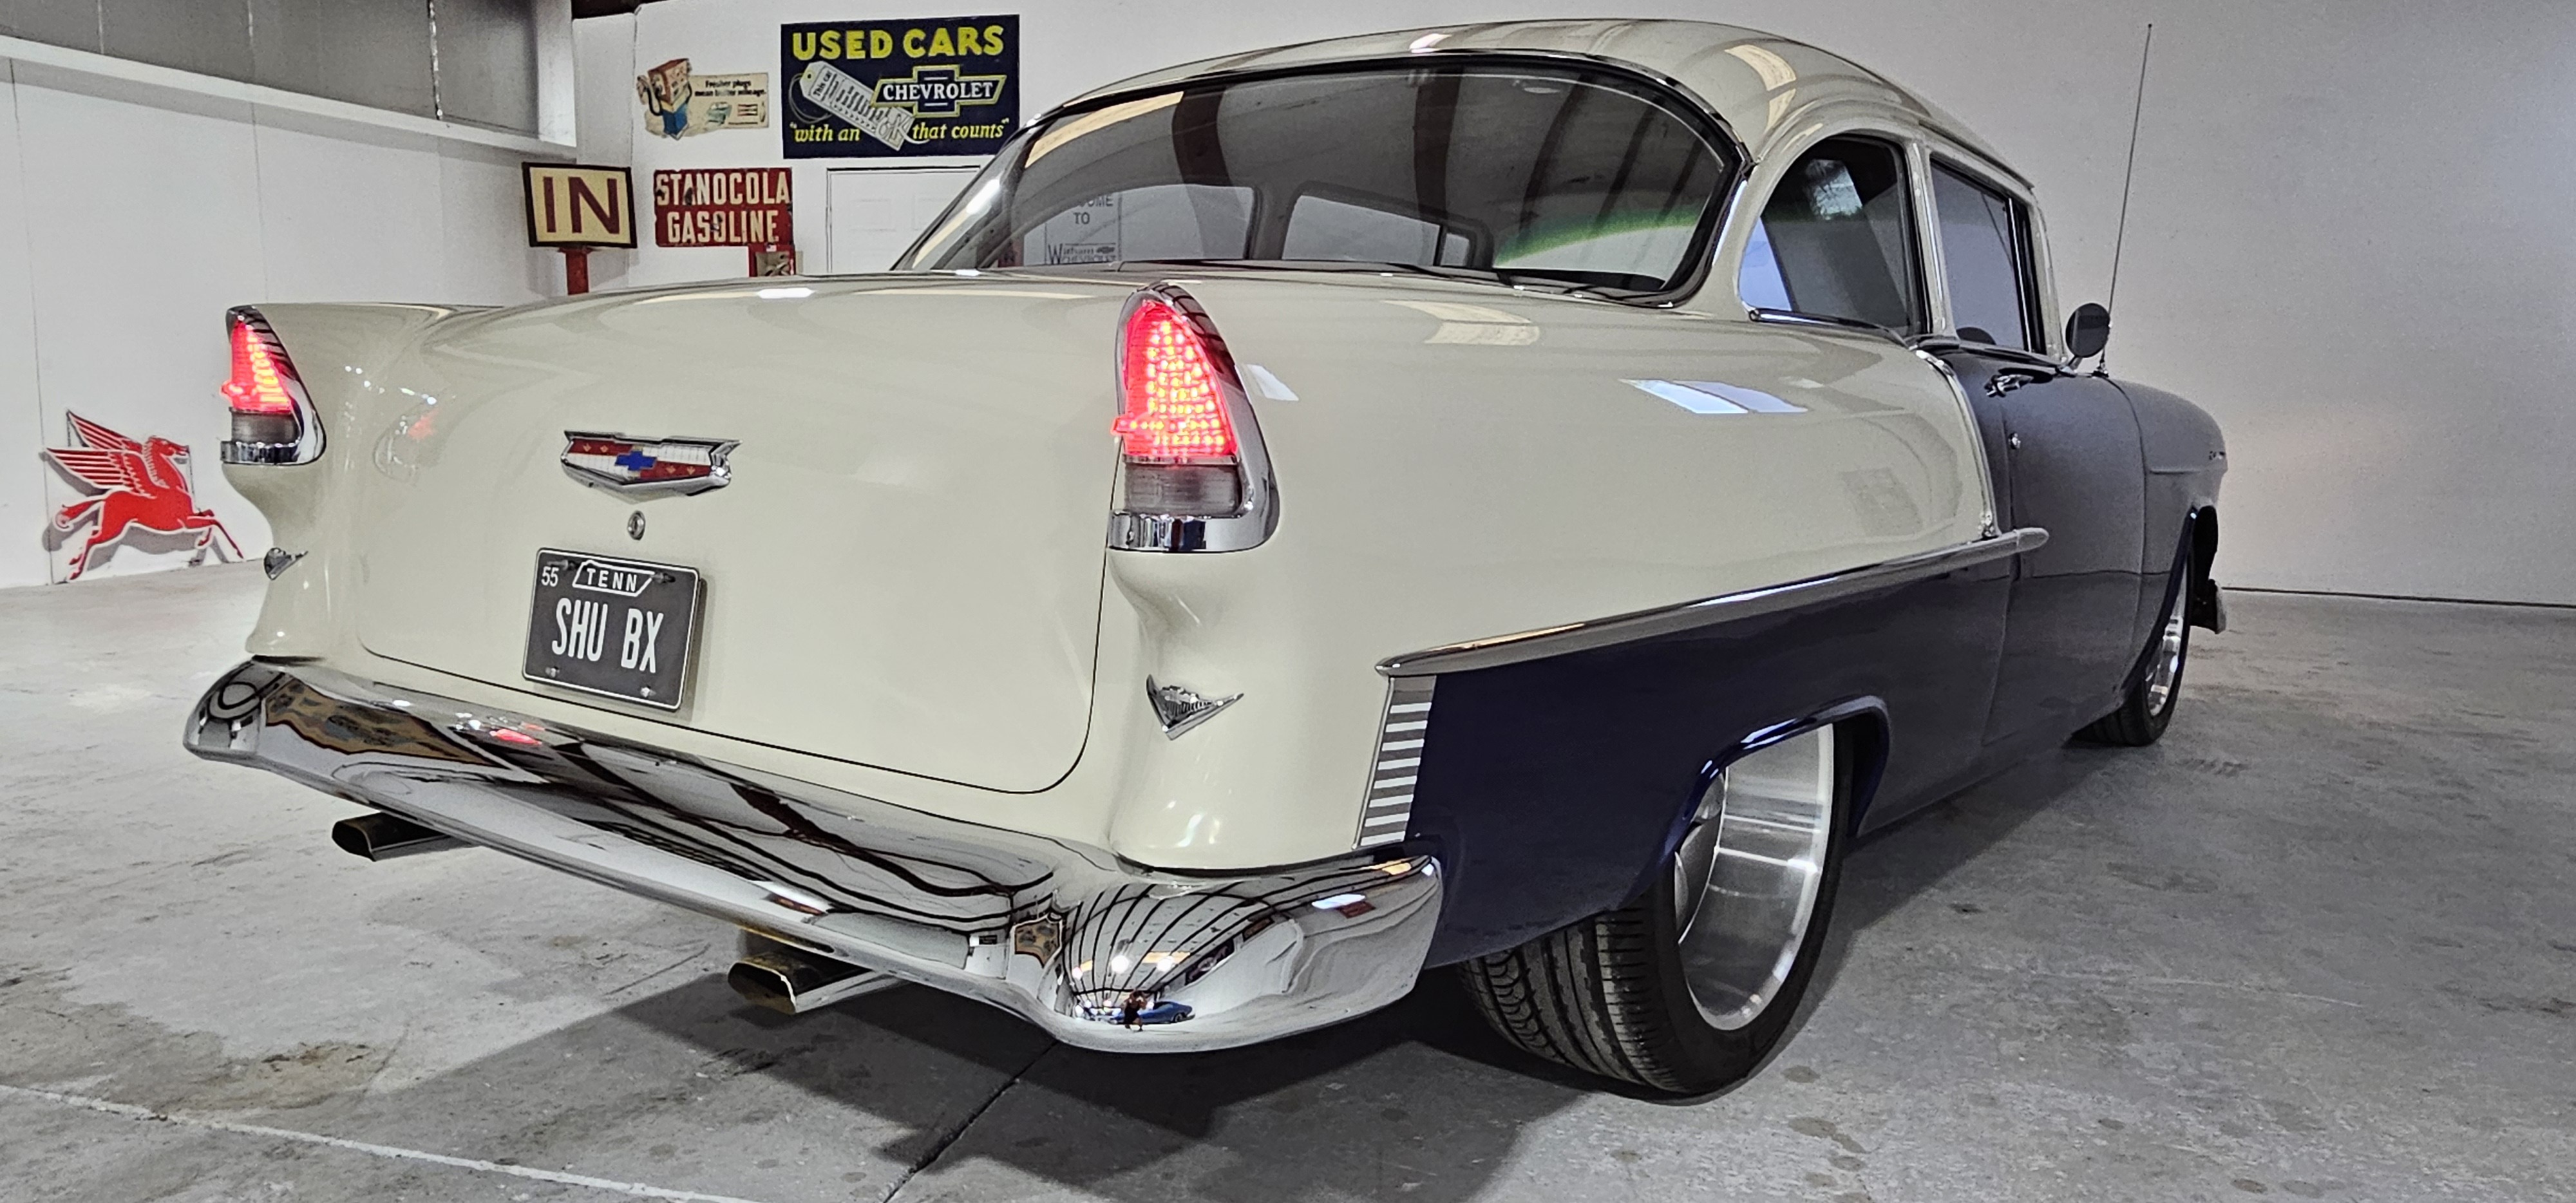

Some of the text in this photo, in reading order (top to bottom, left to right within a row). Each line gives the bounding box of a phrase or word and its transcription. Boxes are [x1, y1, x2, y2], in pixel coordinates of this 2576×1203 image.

[793, 25, 1004, 61] USED CARS
[883, 82, 993, 100] CHEVROLET
[838, 129, 860, 141] an
[912, 122, 947, 139] that
[656, 171, 790, 205] STANOCOLA
[543, 176, 620, 234] IN
[1073, 211, 1090, 225] TO
[667, 210, 779, 243] GASOLINE
[540, 565, 638, 592] 55 TENN
[551, 597, 665, 674] SHU BX
